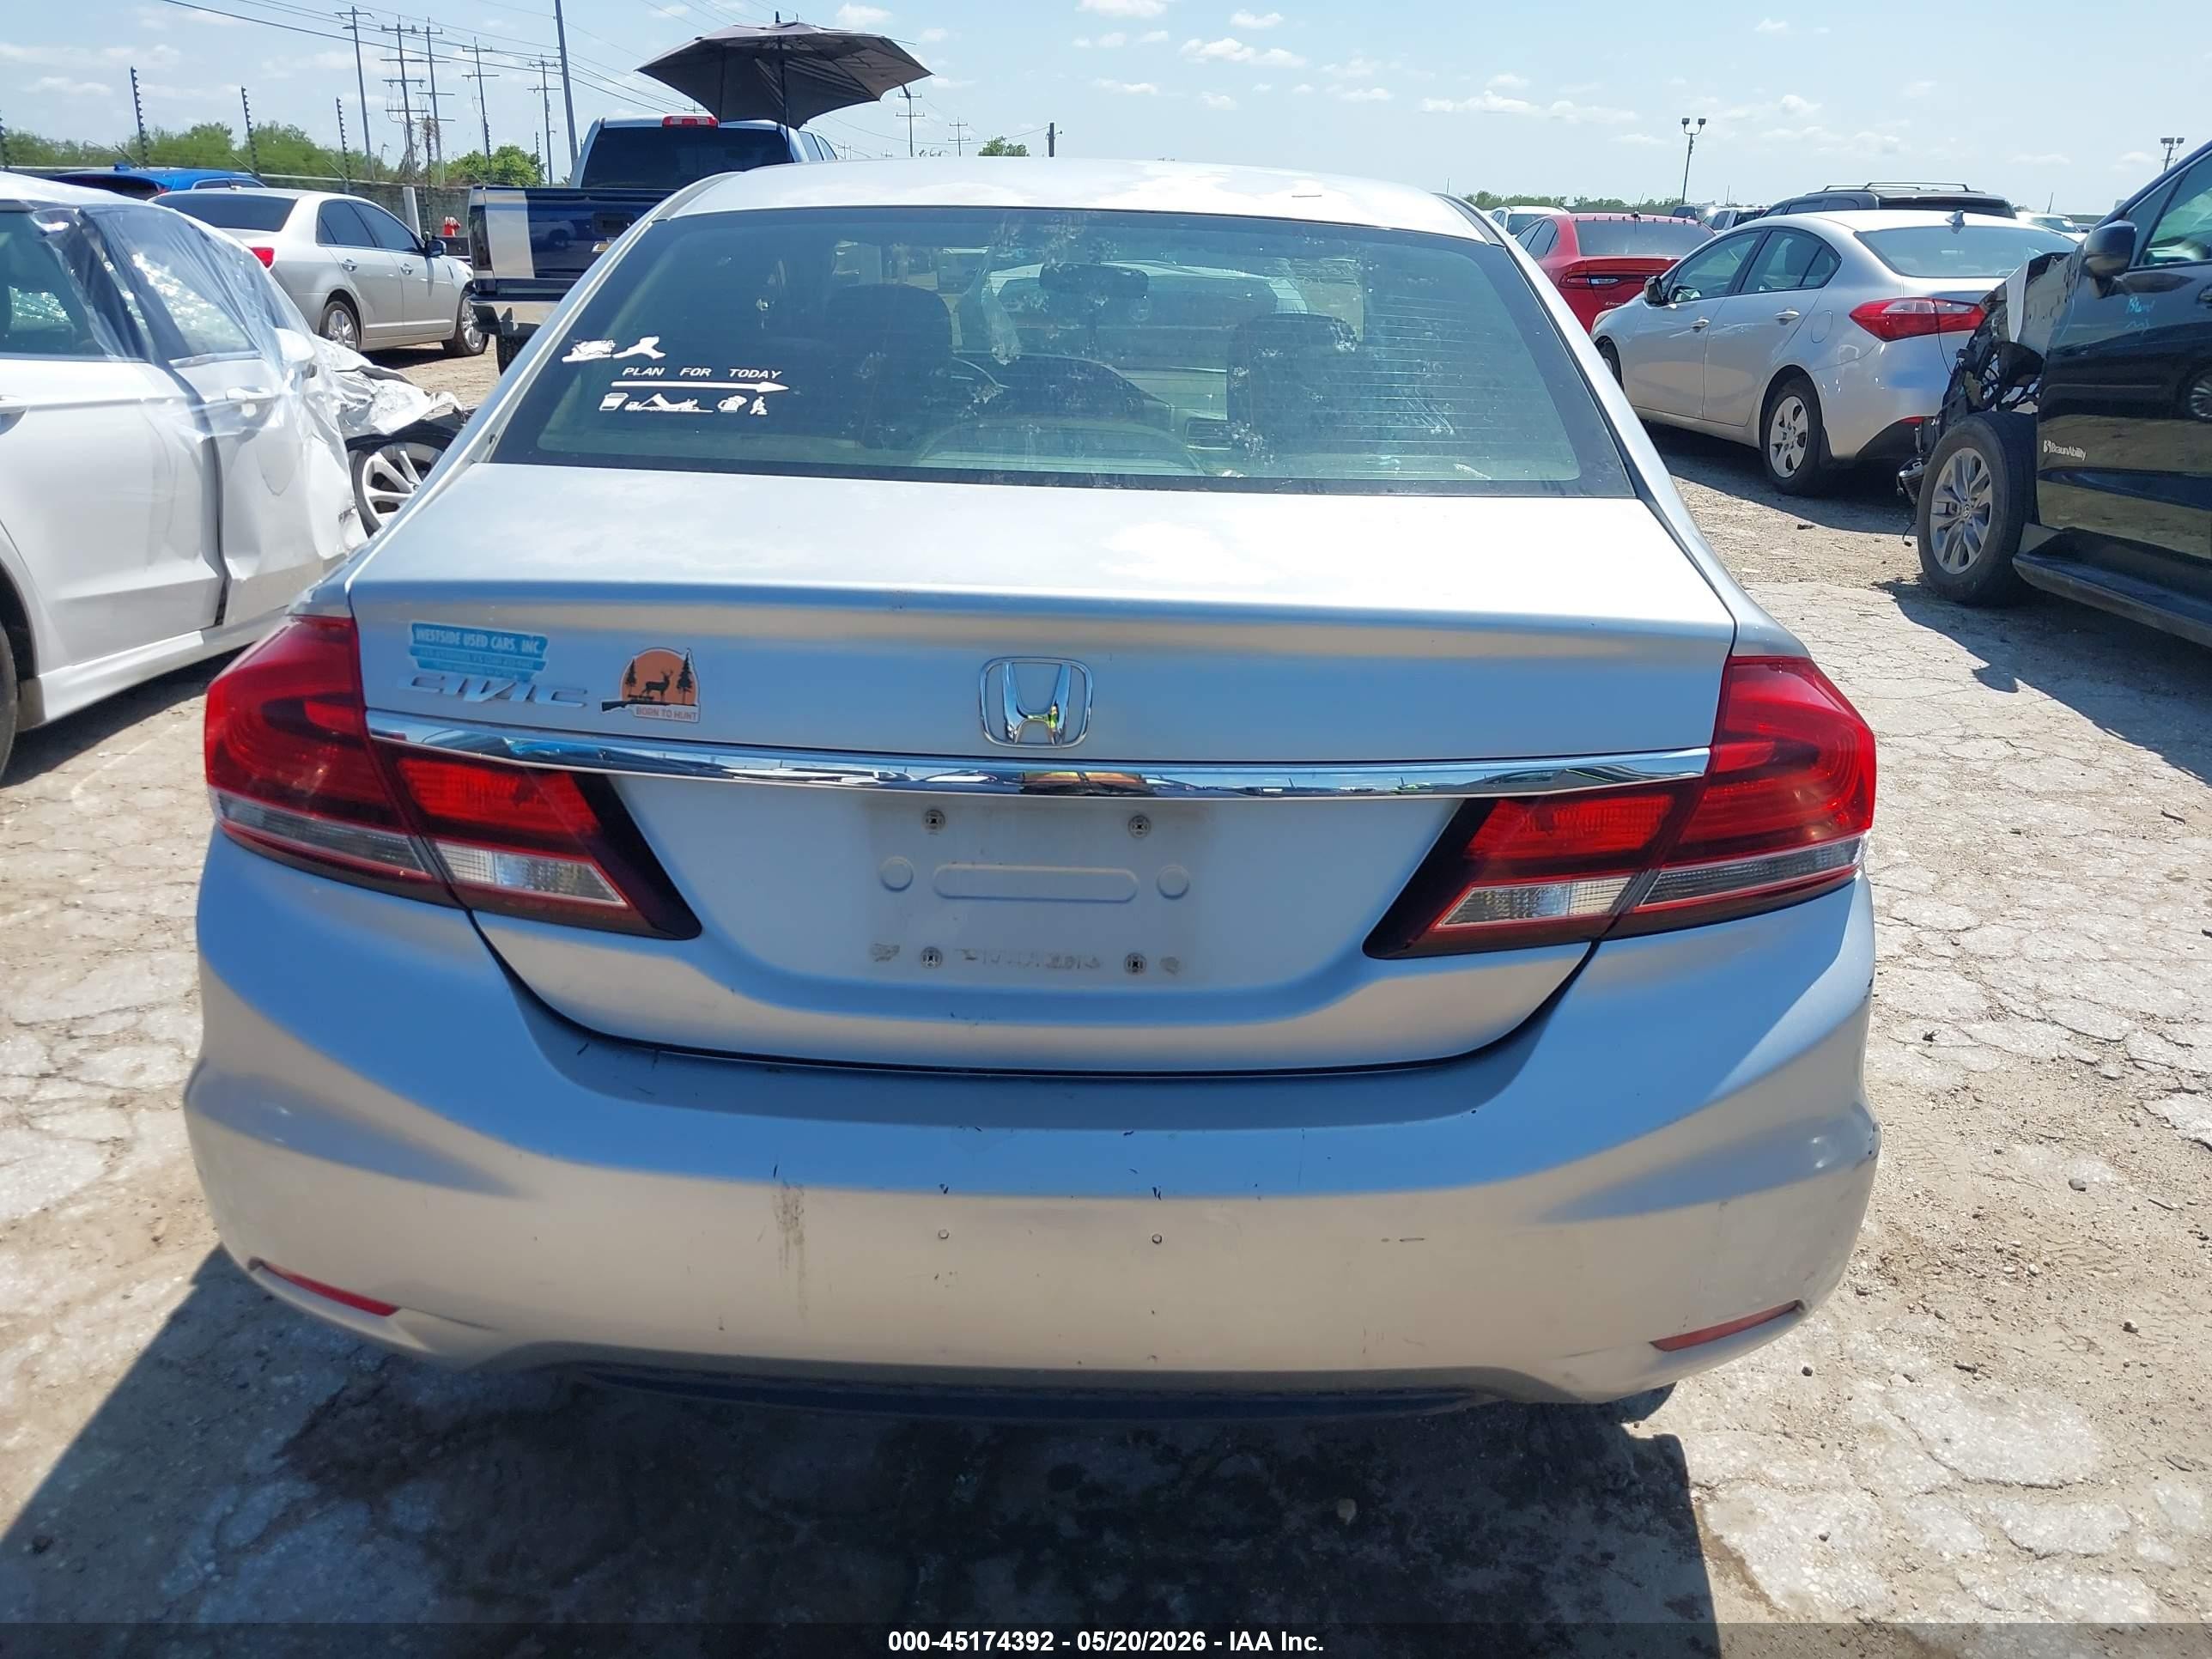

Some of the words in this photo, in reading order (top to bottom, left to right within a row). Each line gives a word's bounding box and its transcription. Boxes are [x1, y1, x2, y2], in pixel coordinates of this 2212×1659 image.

[622, 367, 665, 377] PLAN
[679, 368, 712, 377] FOR
[729, 368, 782, 379] TODAY
[416, 628, 461, 645] WESTSIDE
[463, 633, 489, 647] USED
[400, 673, 588, 708] CIVIC
[636, 706, 659, 717] BORN
[660, 708, 672, 719] TO
[673, 710, 697, 721] HUNT
